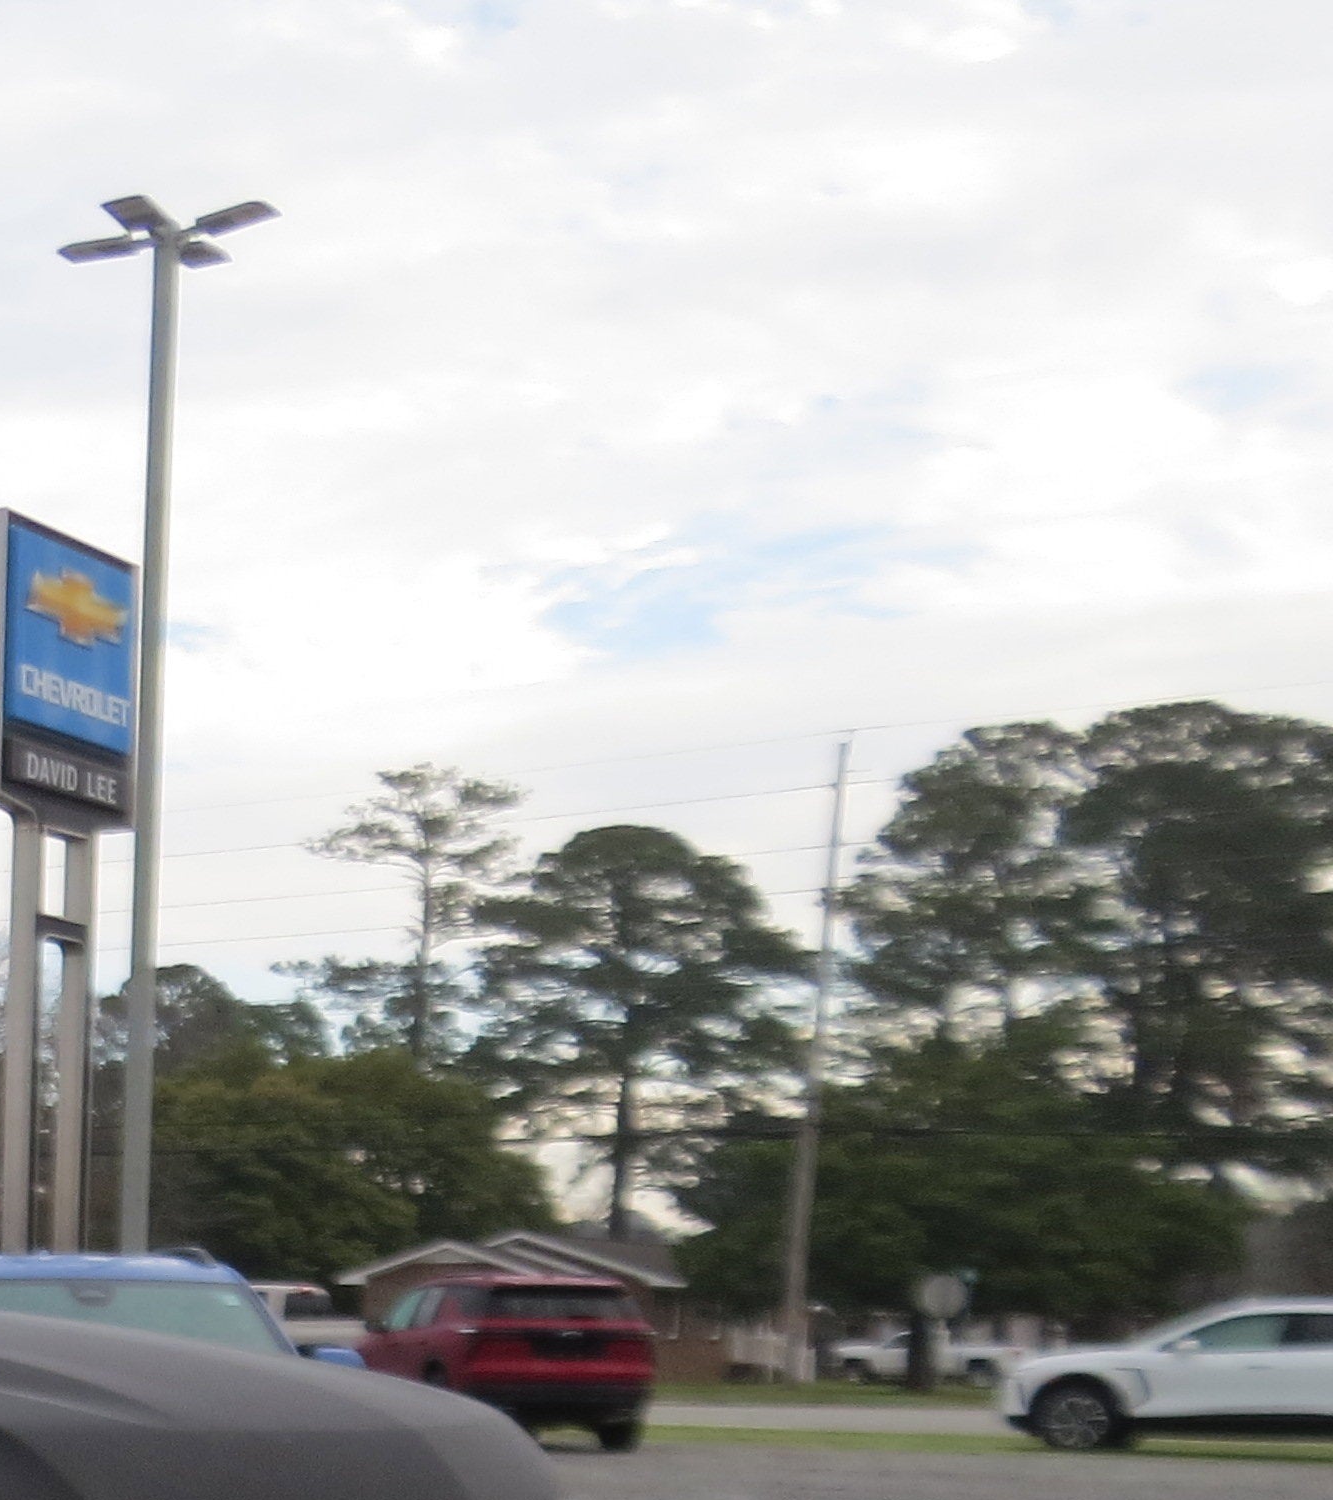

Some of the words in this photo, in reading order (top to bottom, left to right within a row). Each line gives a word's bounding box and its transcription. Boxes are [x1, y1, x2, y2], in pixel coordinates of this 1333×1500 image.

[20, 664, 131, 727] CHEVROLET
[27, 752, 78, 792] DAVID
[87, 770, 118, 803] LEE
